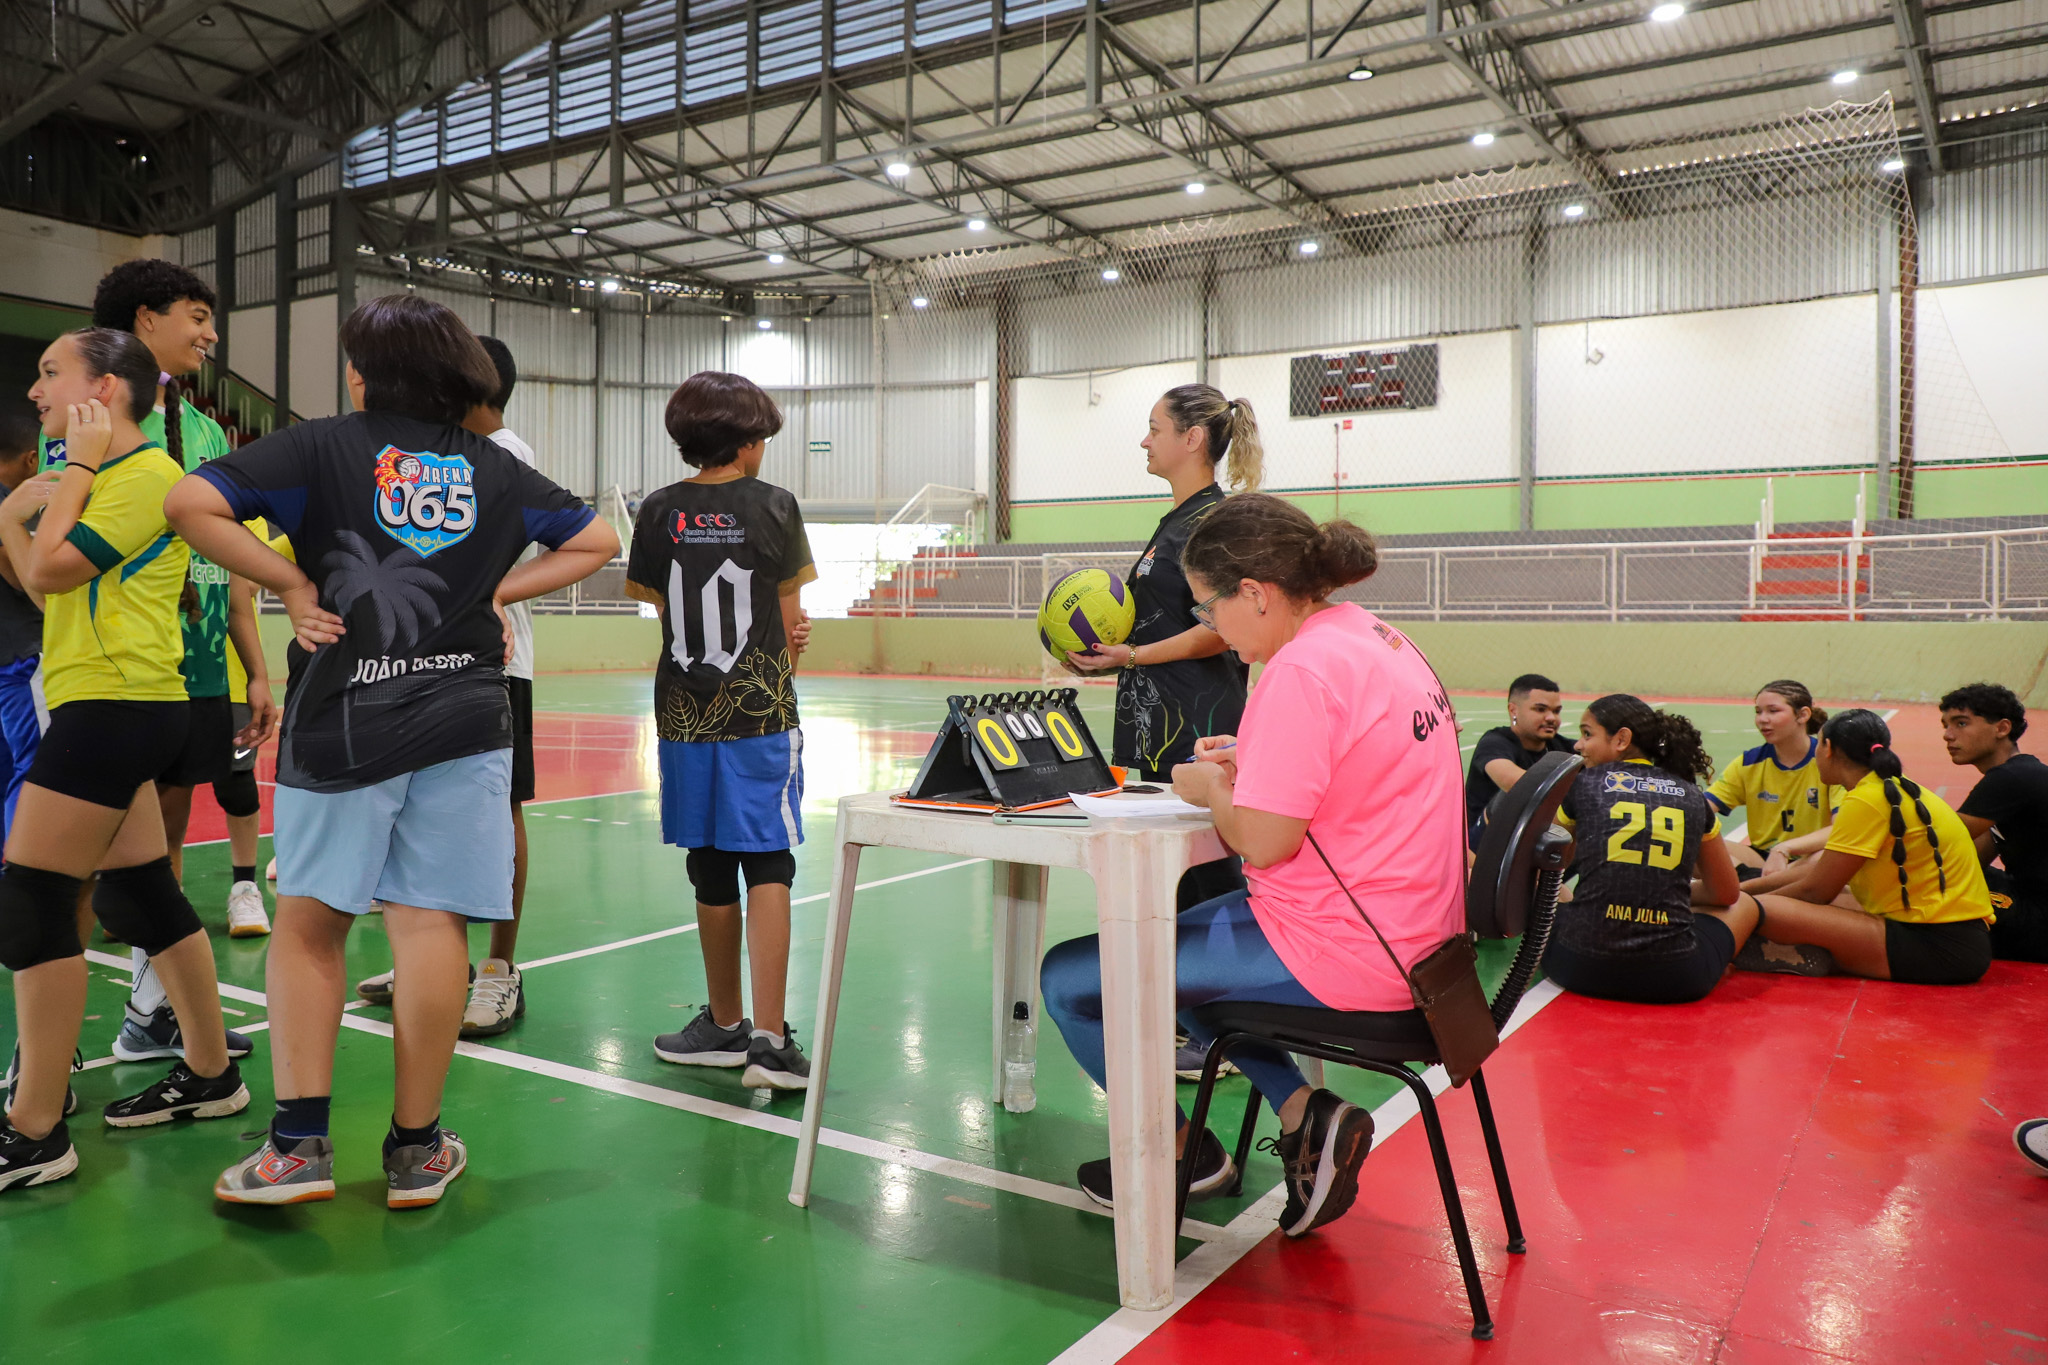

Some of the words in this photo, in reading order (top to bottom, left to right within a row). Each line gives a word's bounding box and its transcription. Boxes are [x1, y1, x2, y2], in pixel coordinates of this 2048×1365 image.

[422, 465, 472, 484] ARENA
[378, 478, 476, 532] 065
[683, 528, 705, 536] Centro
[706, 527, 745, 536] Educacional
[683, 535, 721, 544] Construindo
[668, 558, 754, 673] 10
[350, 655, 407, 684] JOÃO
[977, 718, 1019, 766] 0
[1005, 713, 1027, 739] 0
[1023, 712, 1044, 738] 0
[1046, 711, 1084, 757] 0
[1637, 780, 1686, 797] Exitus
[1607, 801, 1685, 871] 29
[1605, 903, 1632, 920] ANA
[1634, 907, 1669, 926] JULIA
